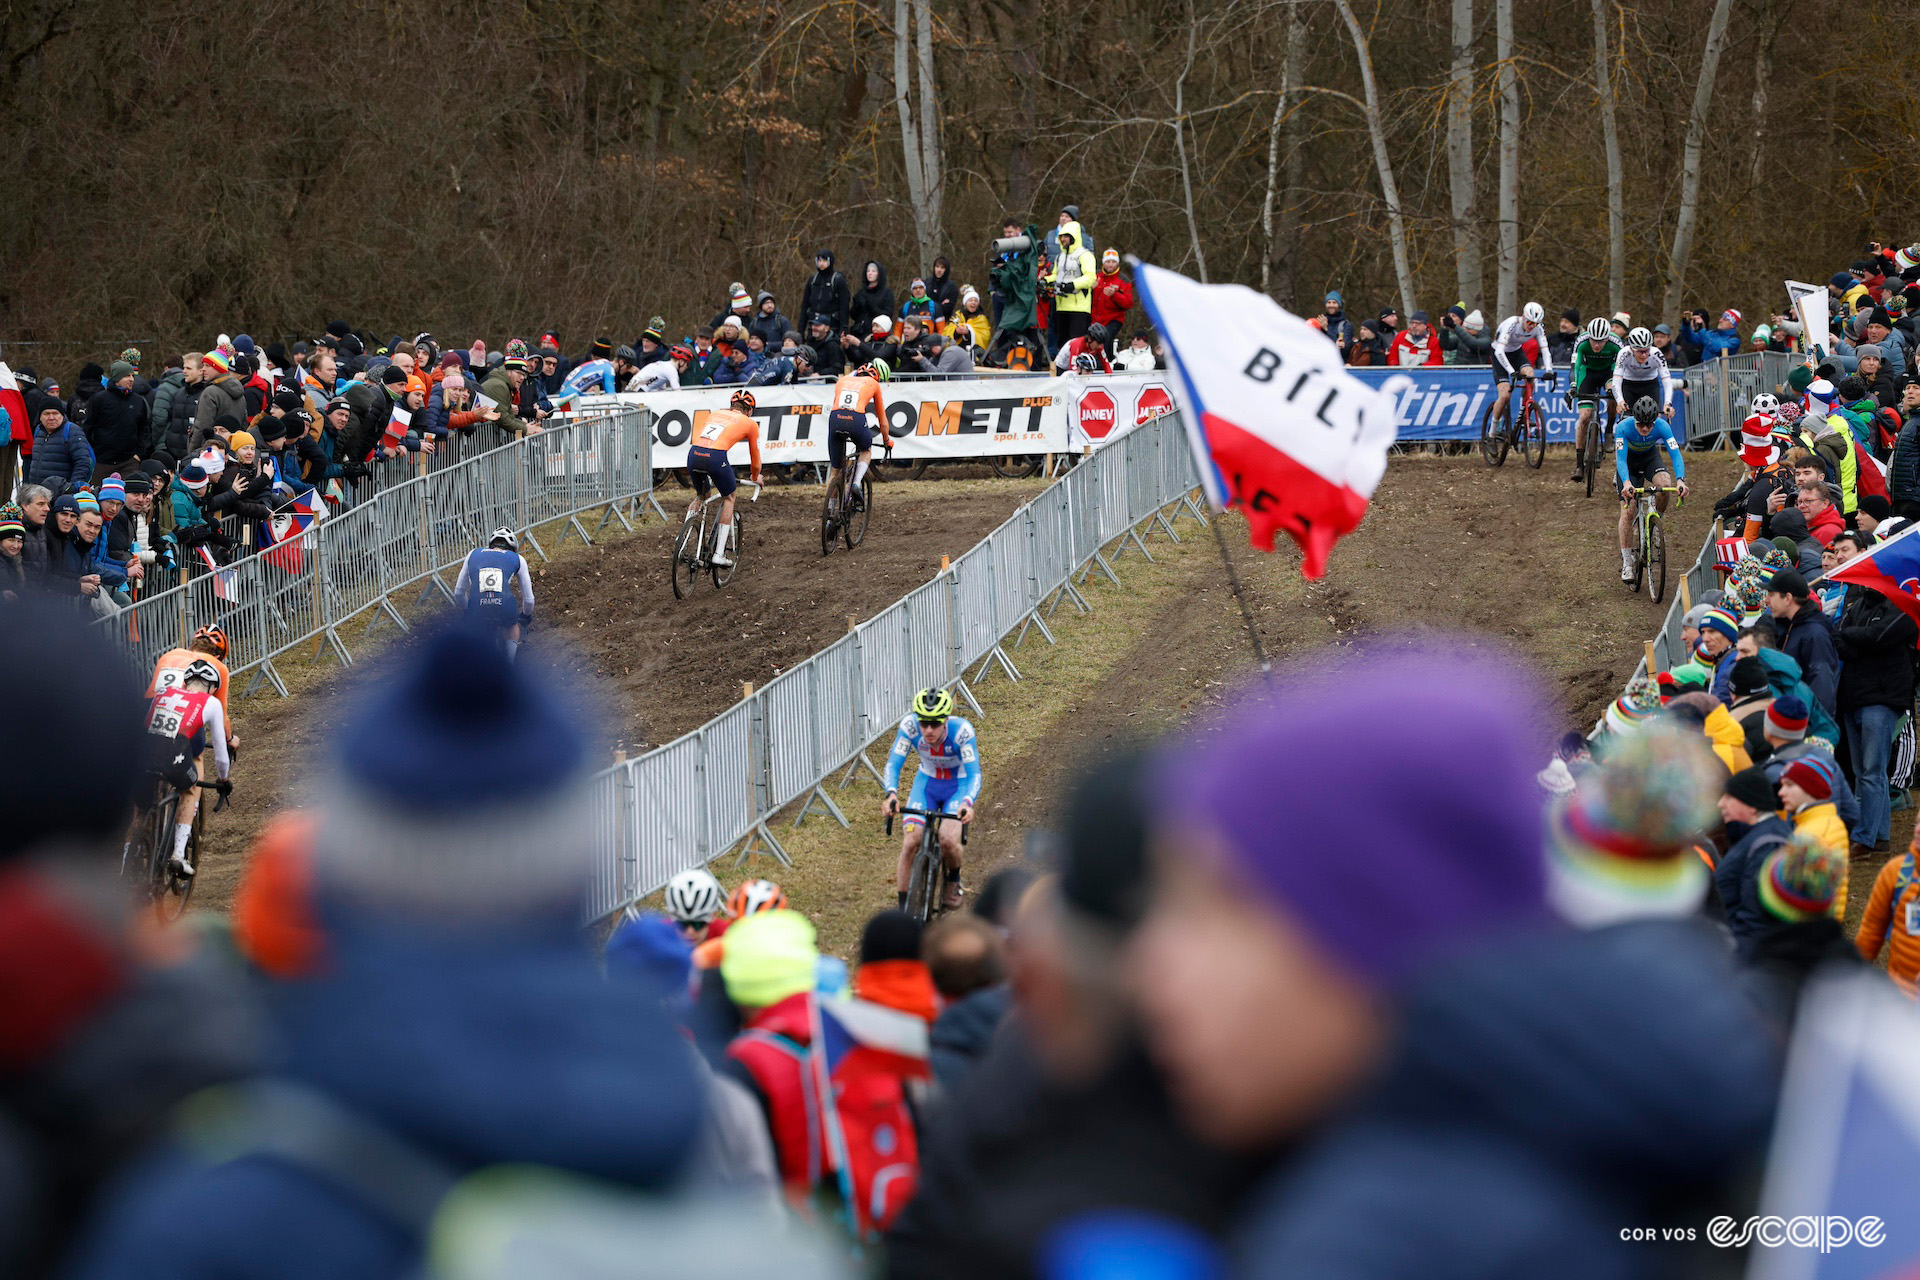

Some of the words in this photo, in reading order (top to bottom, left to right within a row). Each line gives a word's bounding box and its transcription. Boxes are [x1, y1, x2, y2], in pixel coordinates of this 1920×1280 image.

[844, 394, 853, 404] 8
[1023, 396, 1052, 407] PLUS
[790, 405, 823, 415] PLUS
[1081, 409, 1114, 420] JANEV
[707, 426, 717, 435] 7
[994, 432, 1018, 442] spol.
[1030, 432, 1046, 440] r.o.
[765, 440, 789, 449] spol.
[800, 440, 816, 448] r.o.
[485, 574, 496, 587] 6
[164, 673, 176, 686] 9
[152, 713, 178, 732] 58
[898, 742, 908, 752] 33
